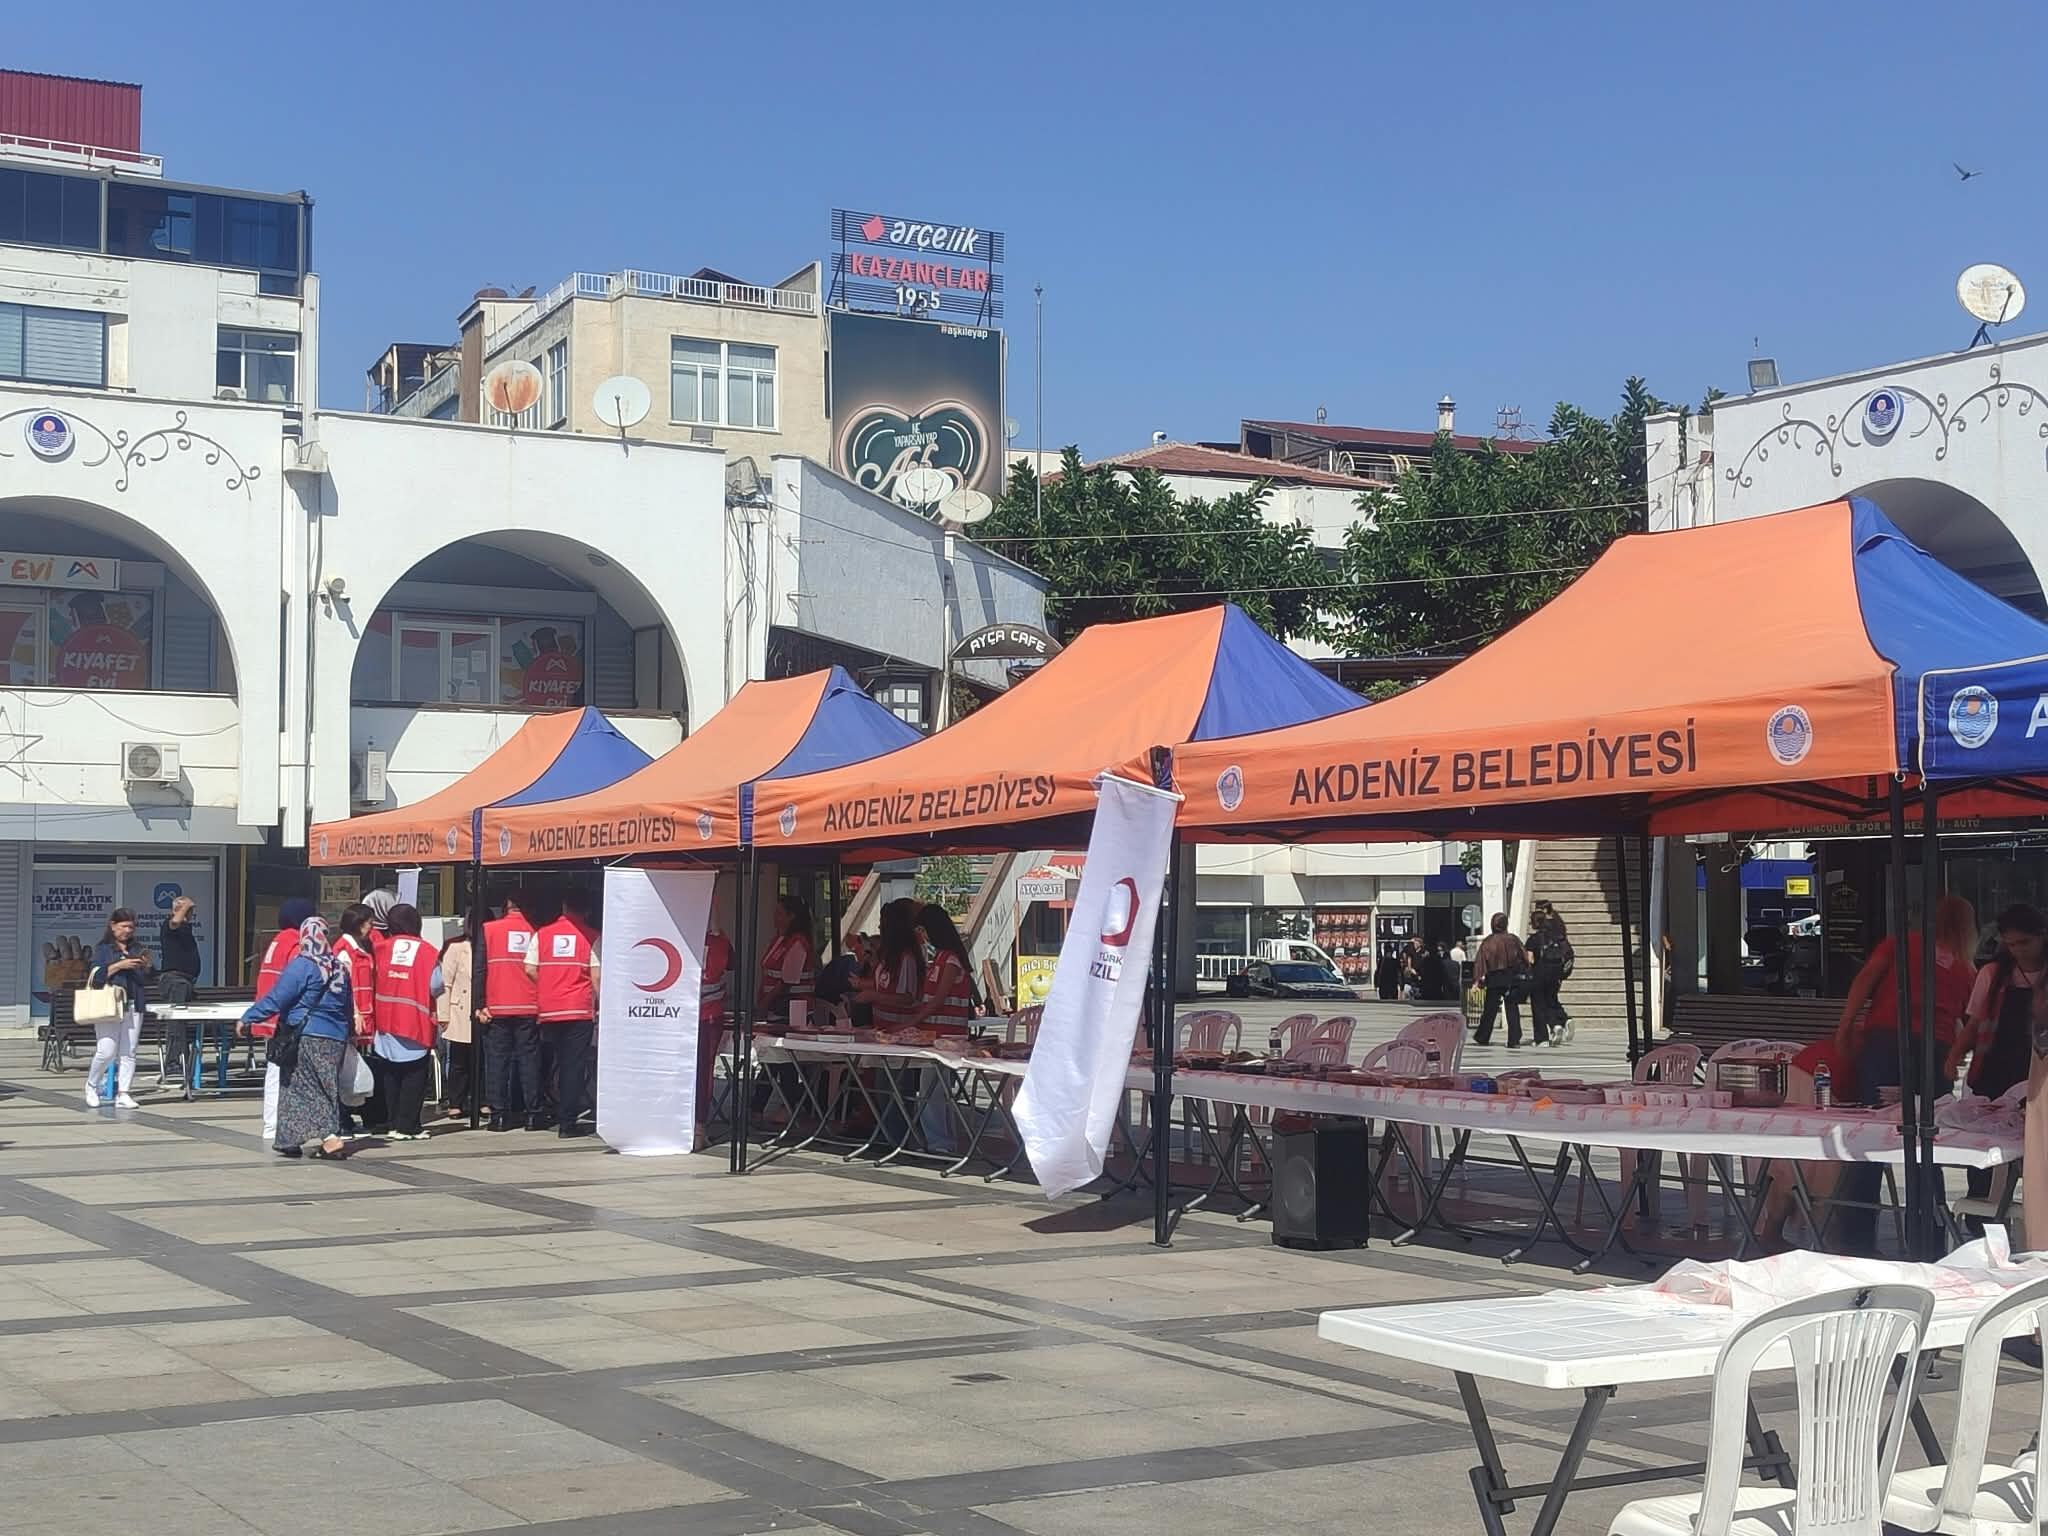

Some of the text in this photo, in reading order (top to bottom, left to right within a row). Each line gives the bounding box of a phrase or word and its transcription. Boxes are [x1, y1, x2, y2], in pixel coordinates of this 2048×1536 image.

[890, 221, 979, 254] arçelik
[851, 252, 989, 292] KAZANÇLAR
[895, 286, 941, 310] 1955
[970, 629, 1047, 655] AYÇA CAFE
[63, 651, 140, 671] KIYAFET
[1288, 717, 1697, 806] AKDENİZ BELEDİYESİ
[824, 774, 1056, 832] AKDENİZ BELEDİYESİ
[338, 828, 434, 857] AKDENİZ BELEDİYESİ
[528, 811, 676, 853] AKDENİZ BELEDİYESİ
[46, 895, 76, 903] KART
[78, 895, 113, 903] ARTIK
[48, 884, 93, 895] MERSİN
[1021, 883, 1041, 897] AYÇA
[40, 903, 103, 911] HER YERDE
[628, 1005, 681, 1018] KIZILAY
[645, 996, 666, 1005] TÜRK
